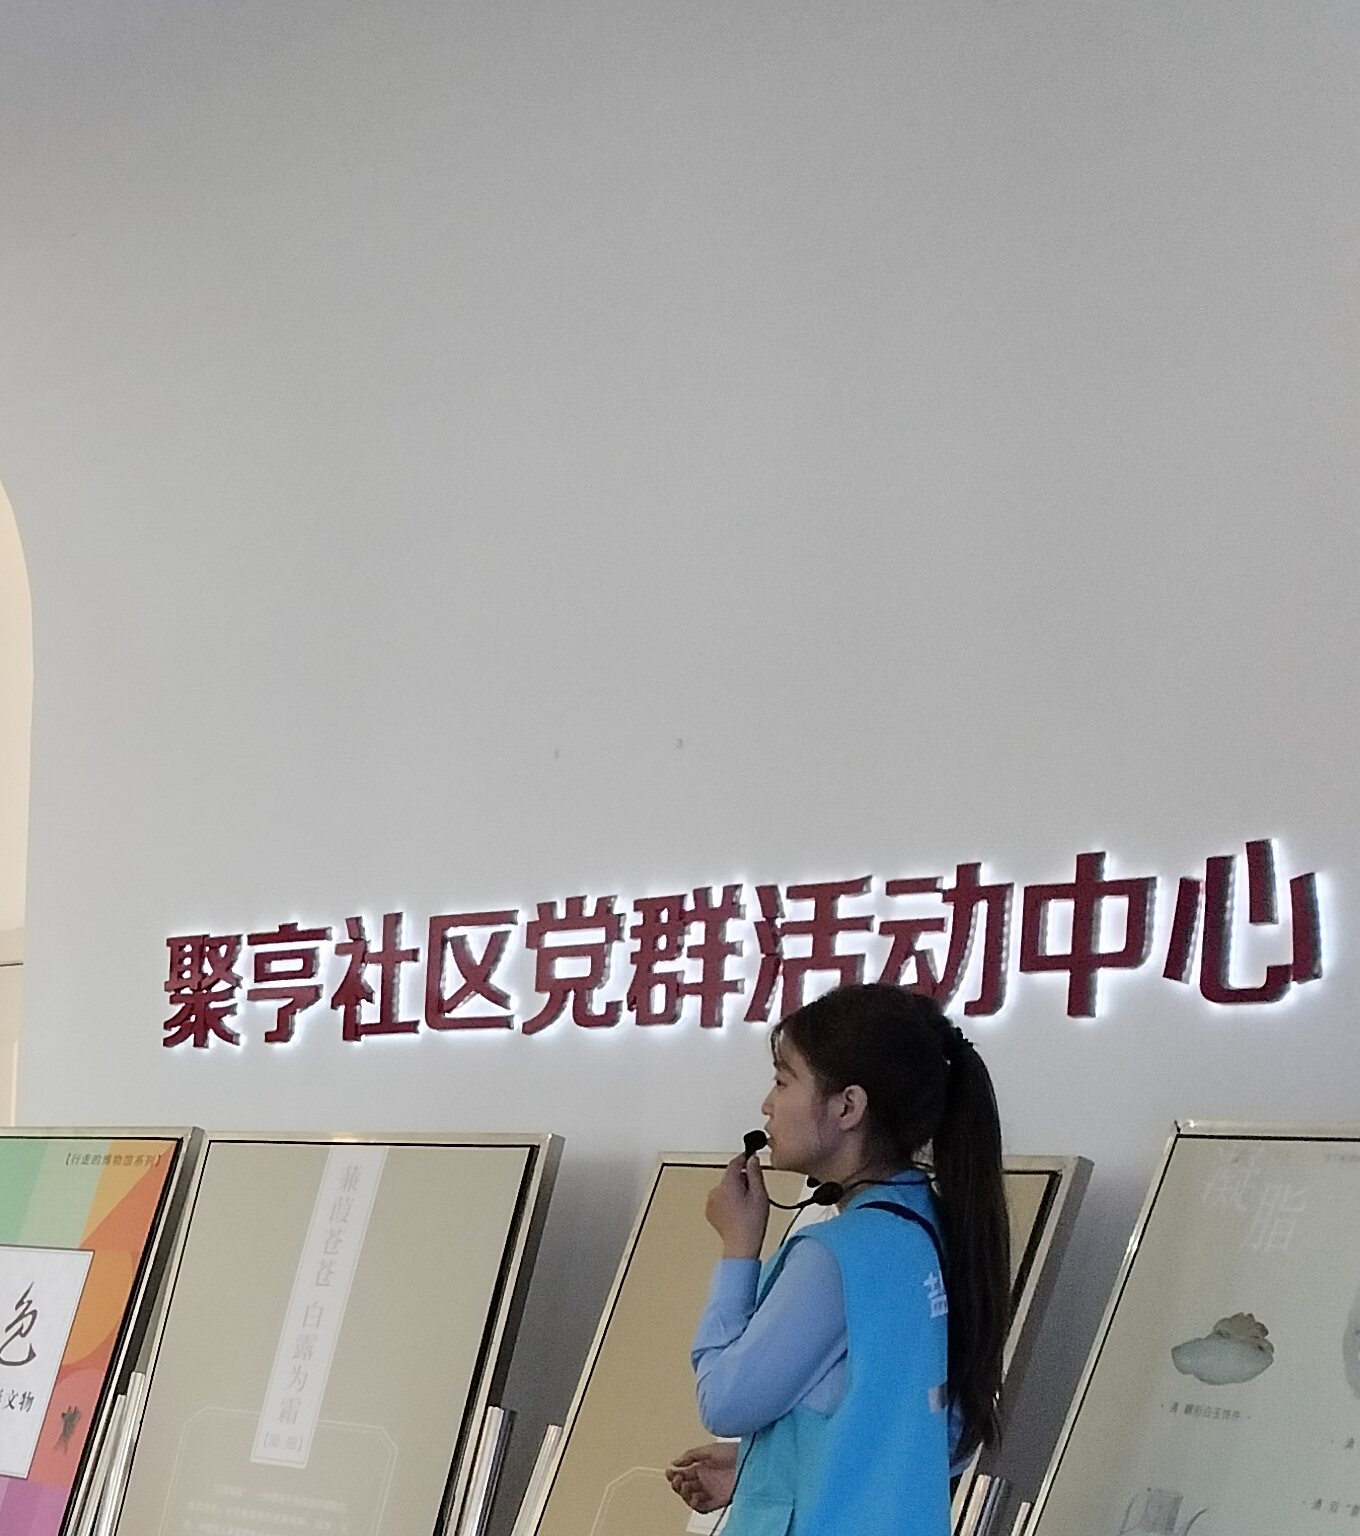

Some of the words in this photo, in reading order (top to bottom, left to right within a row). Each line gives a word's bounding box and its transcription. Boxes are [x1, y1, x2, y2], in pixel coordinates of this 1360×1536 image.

[163, 838, 1322, 1048] 聚亨社区党群活动中心
